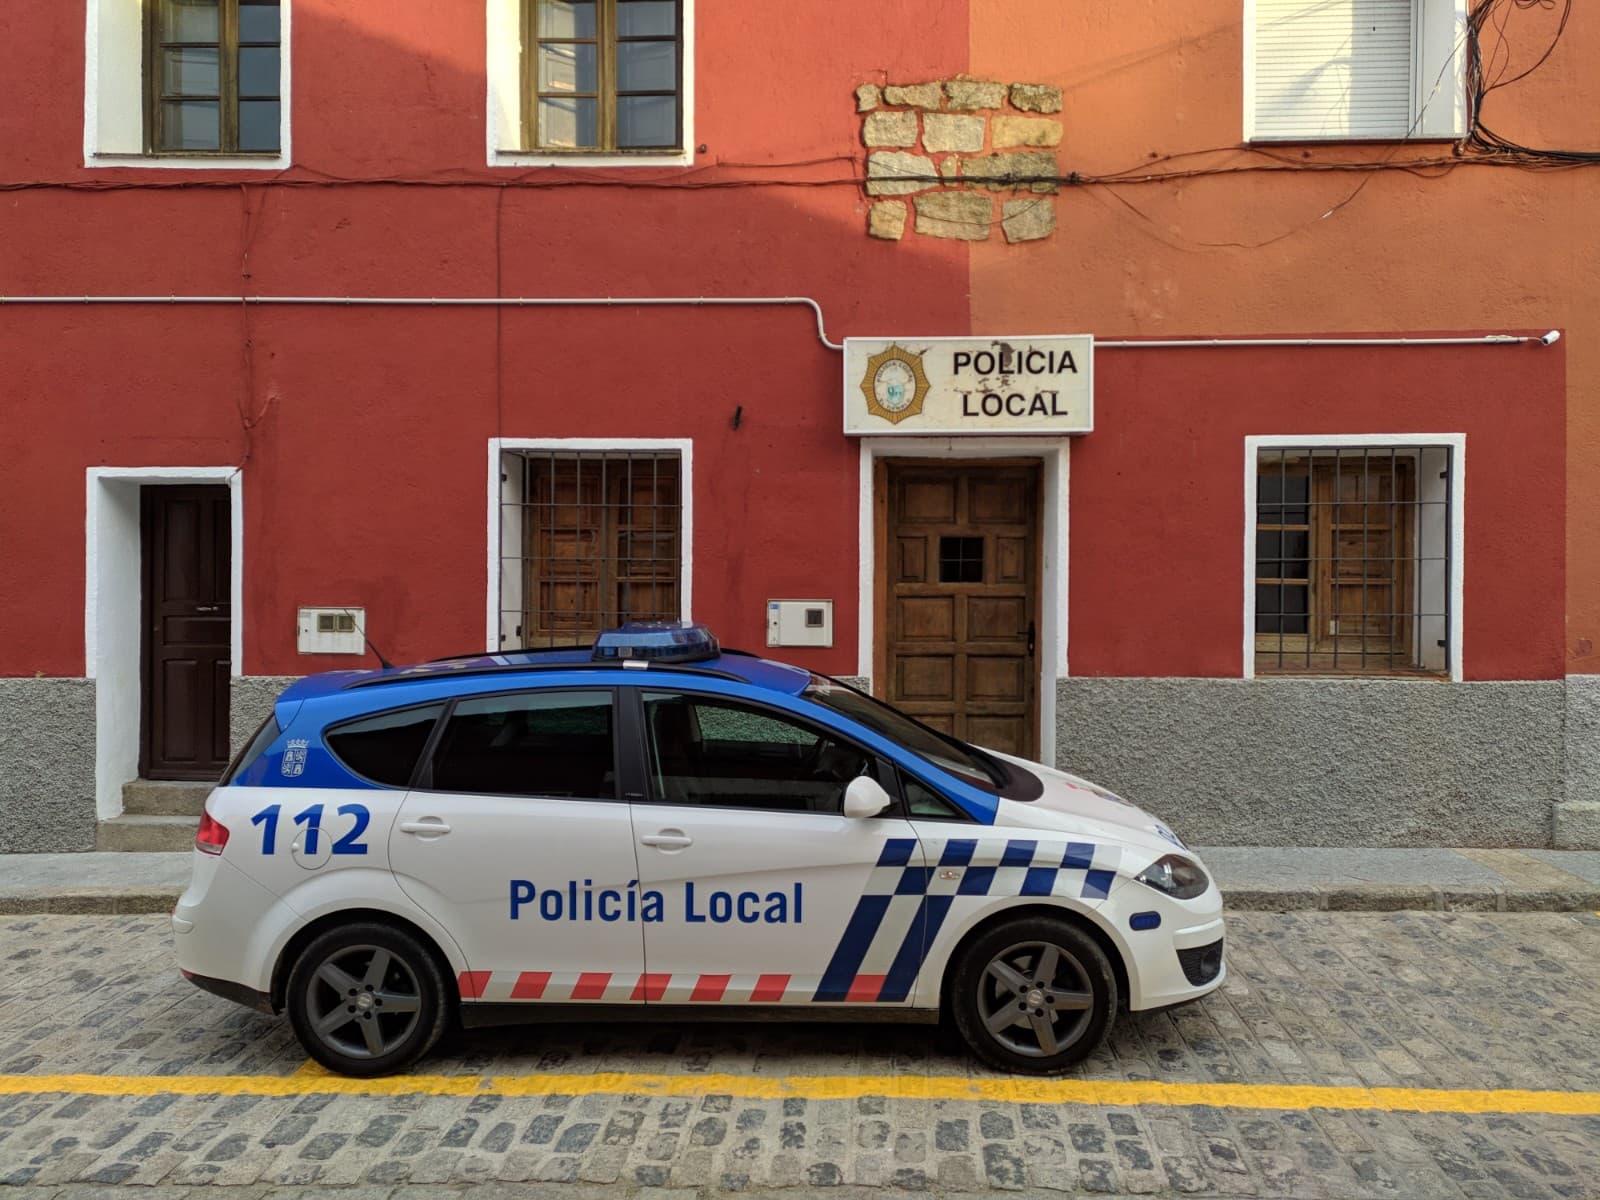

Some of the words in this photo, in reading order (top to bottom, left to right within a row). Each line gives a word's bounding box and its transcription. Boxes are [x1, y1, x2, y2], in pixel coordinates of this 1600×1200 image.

[954, 350, 1078, 375] POLICIA
[963, 393, 1068, 417] LOCAL
[251, 803, 371, 855] 112
[510, 879, 664, 923] Policía
[685, 881, 802, 924] Local
